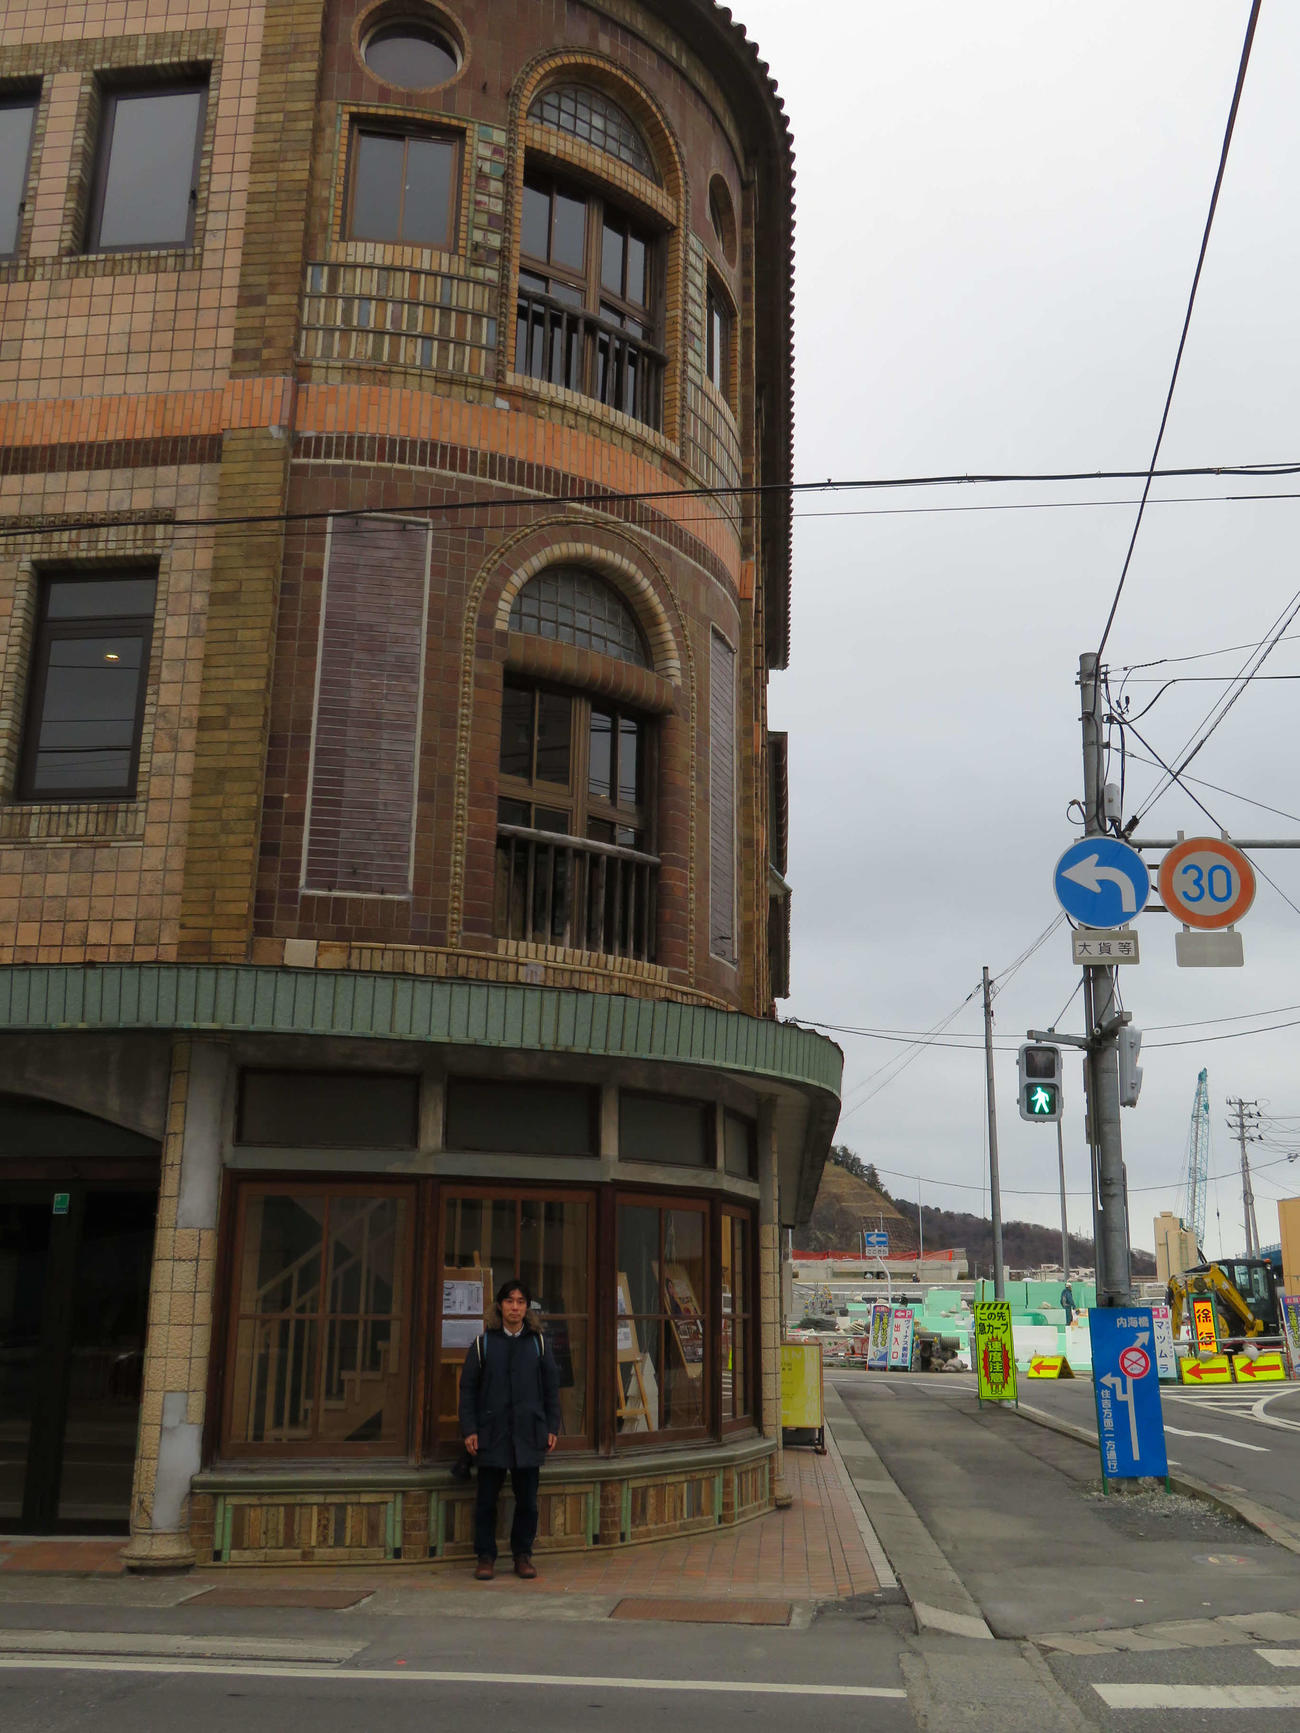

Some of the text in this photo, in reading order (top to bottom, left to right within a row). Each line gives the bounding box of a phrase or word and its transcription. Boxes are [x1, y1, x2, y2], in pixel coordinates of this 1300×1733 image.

[1181, 863, 1232, 903] 30
[1078, 941, 1133, 956] 大貨等
[979, 1311, 1007, 1322] この先
[1116, 1316, 1150, 1329] 内海橋
[1196, 1308, 1215, 1346] 徐行
[891, 1323, 901, 1360] 出入口
[1154, 1320, 1169, 1373] マツムラ
